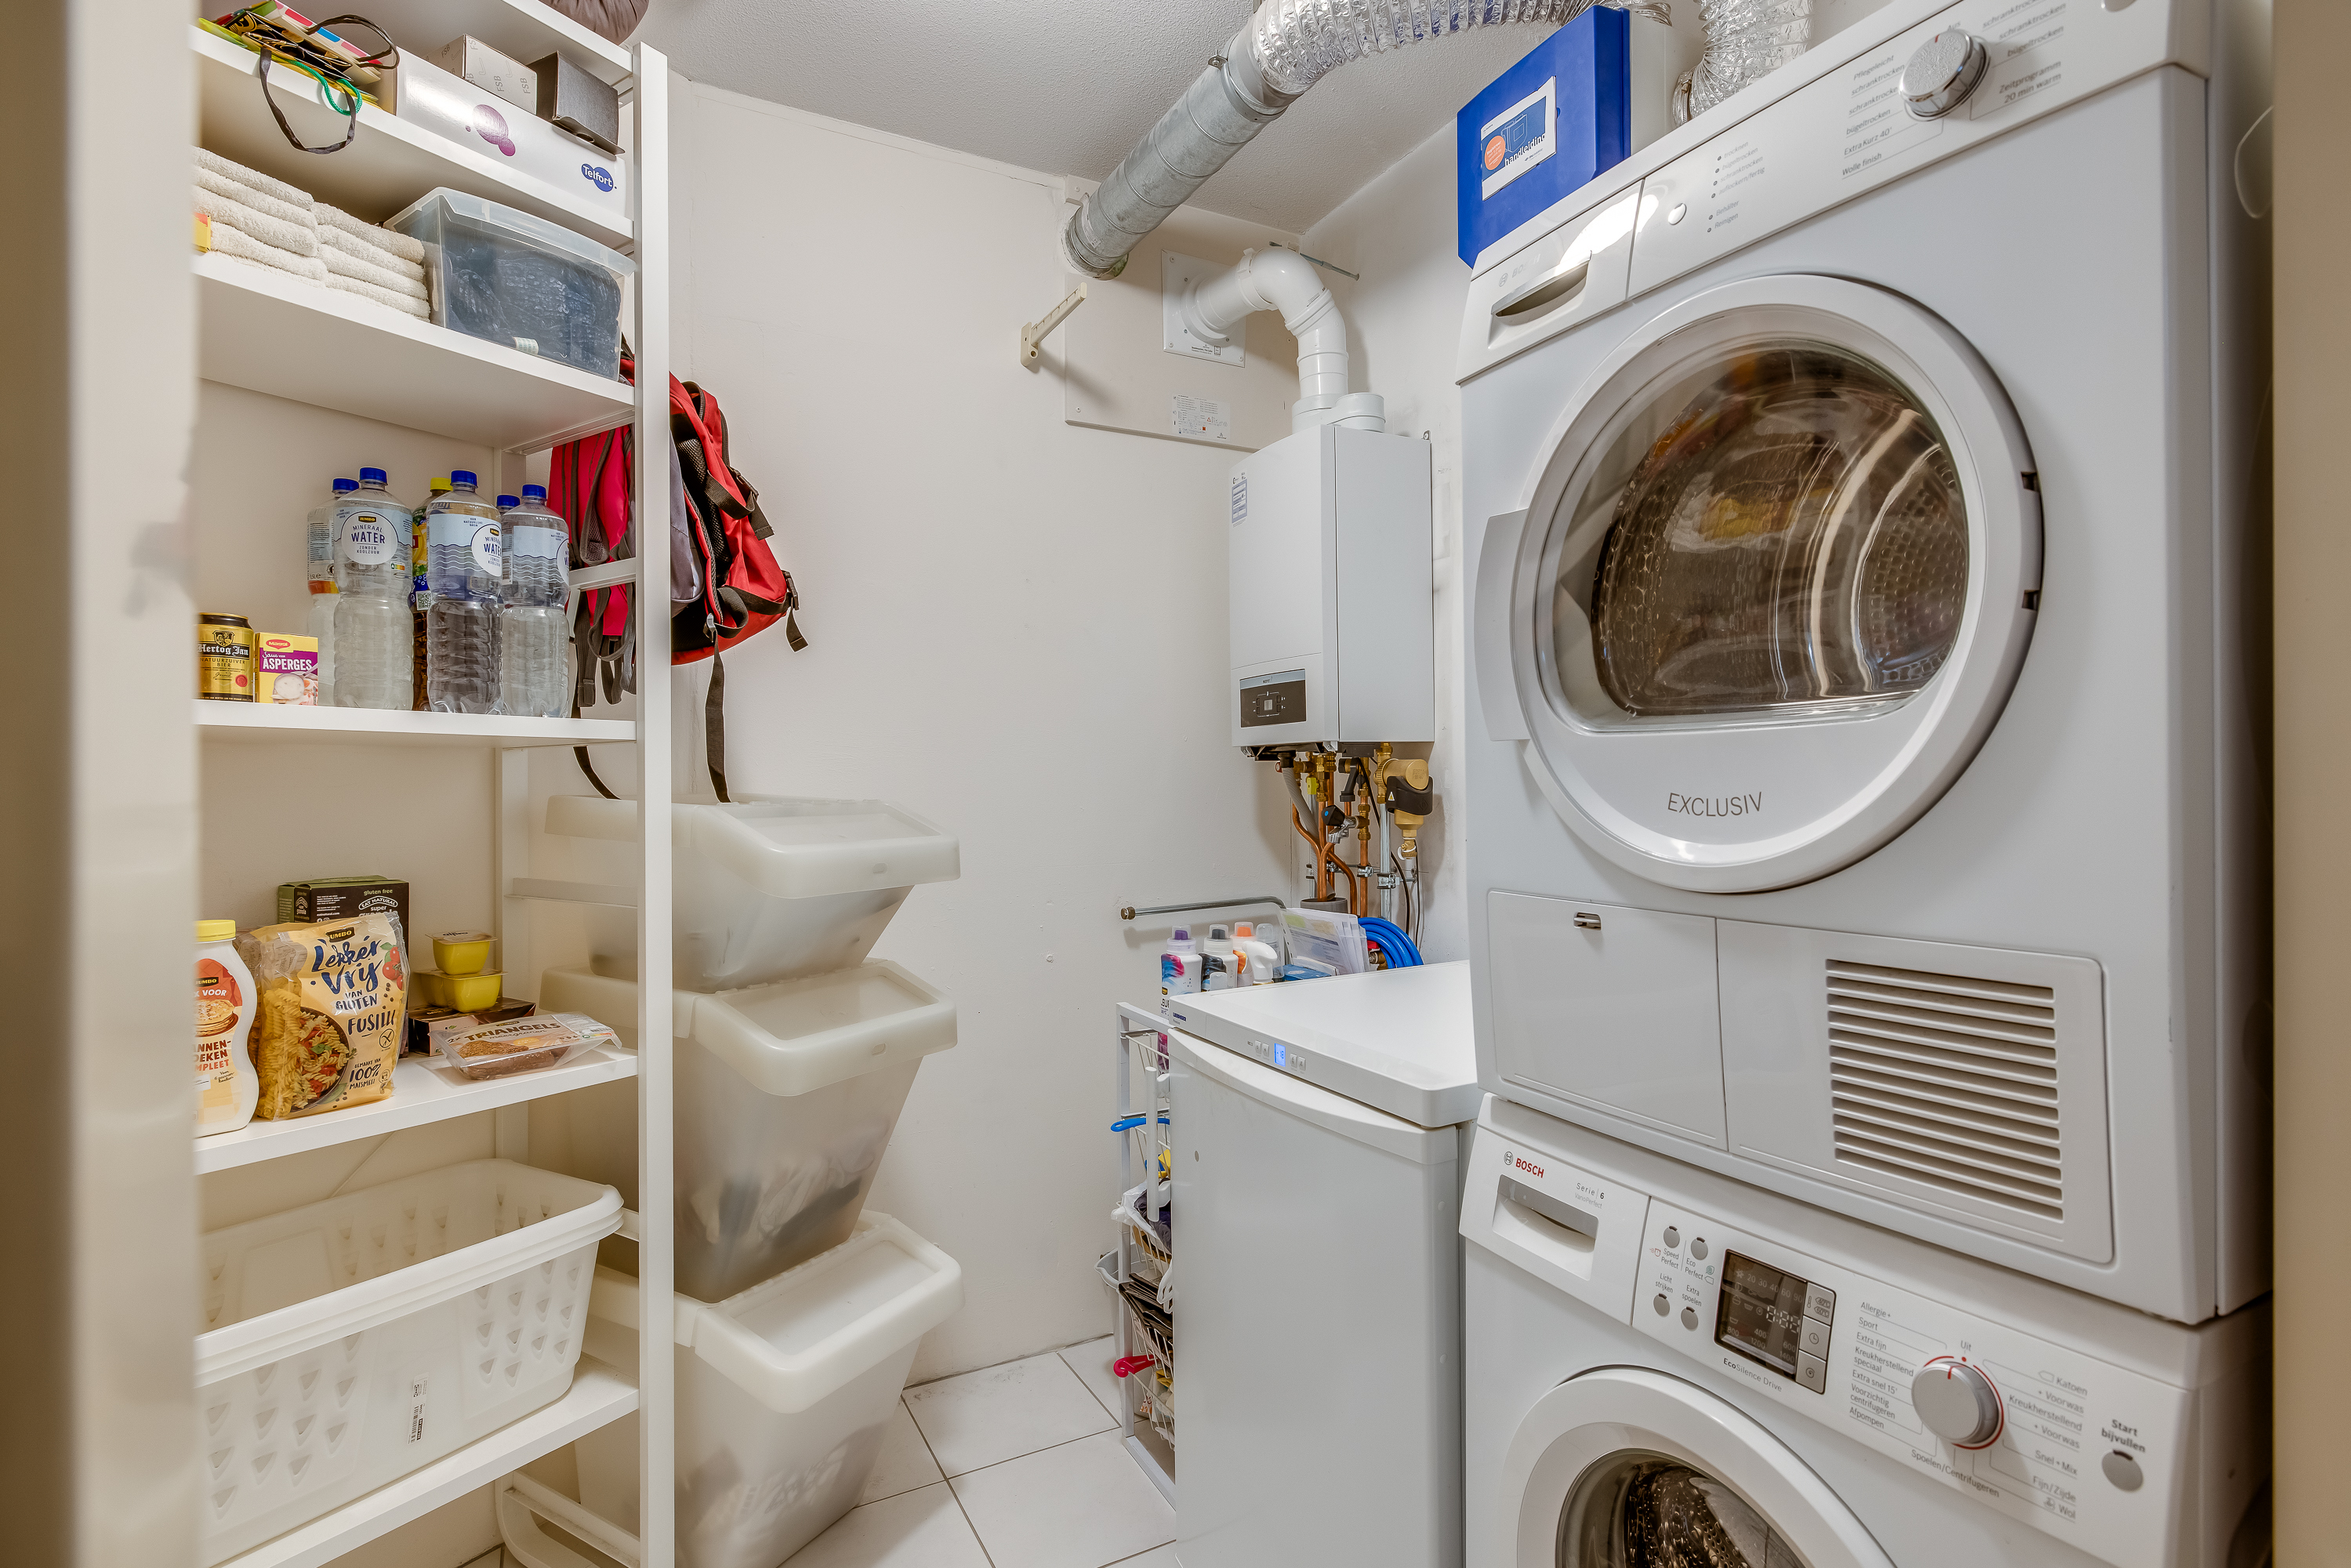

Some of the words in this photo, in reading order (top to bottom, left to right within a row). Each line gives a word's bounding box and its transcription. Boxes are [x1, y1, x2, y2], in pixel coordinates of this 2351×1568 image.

[441, 44, 451, 58] FSB
[1853, 55, 1894, 81] Pflegeleicht
[1999, 61, 2062, 93] Zeitprogramm
[494, 75, 504, 92] FSB
[521, 78, 531, 94] FSB
[1852, 64, 1905, 96] schranktrocken
[2005, 92, 2016, 103] 20
[2018, 85, 2034, 96] min
[2037, 74, 2061, 88] warm
[1846, 109, 1891, 135] bügeltrocken
[1724, 142, 1748, 158] trocknen
[1844, 143, 1862, 155] Extra
[1863, 134, 1878, 147] Kurz
[1720, 157, 1763, 183] schranktrocken
[1842, 163, 1861, 176] Wolle
[1863, 153, 1881, 167] finish
[582, 165, 613, 187] Telfort
[1716, 201, 1740, 216] Behälter
[1714, 213, 1739, 229] Reinigen
[351, 532, 386, 544] WATER
[197, 644, 231, 655] Hertog
[232, 645, 249, 656] Jan
[263, 658, 313, 670] ASPERGES
[1667, 791, 1761, 817] EXCLUSIV
[329, 930, 352, 939] UMBO
[311, 939, 382, 972] Lekker
[321, 960, 383, 995] Vrij
[345, 989, 362, 998] VAN
[348, 1009, 396, 1035] FUSILLI
[464, 1023, 561, 1041] TRIANGELS
[194, 1059, 229, 1072] MPLEET
[350, 1064, 382, 1083] 100%
[1515, 1157, 1545, 1178] BOSCH
[1576, 1182, 1595, 1196] Serie
[1574, 1192, 1603, 1210] VarioPerfect
[1661, 1256, 1679, 1269] Perfect
[1663, 1247, 1679, 1260] Speed
[1685, 1258, 1696, 1268] Eco
[1660, 1272, 1672, 1283] Licht
[1685, 1266, 1704, 1280] Perfect
[1655, 1280, 1674, 1294] strijken
[1686, 1284, 1700, 1296] Extra
[1747, 1273, 1756, 1283] 20
[1758, 1278, 1768, 1288] 30
[1769, 1283, 1780, 1293] 40
[1781, 1288, 1791, 1298] 60
[1793, 1294, 1803, 1303] 90
[1682, 1293, 1702, 1307] spoelen
[1860, 1301, 1887, 1318] Allergie
[1727, 1326, 1740, 1338] 800
[1754, 1327, 1767, 1339] 400
[1859, 1316, 1878, 1331] Sport
[1751, 1337, 1765, 1349] 1200
[1783, 1341, 1796, 1352] 600
[1856, 1331, 1874, 1345] Extra
[1875, 1339, 1887, 1351] fijn
[1961, 1340, 1972, 1352] Uit
[1779, 1350, 1795, 1364] 1400
[1854, 1356, 1882, 1373] speciaal
[1855, 1345, 1914, 1377] Kreukherstellend
[1723, 1357, 1761, 1382] EcoSilence
[1763, 1377, 1783, 1392] Drive
[1852, 1369, 1870, 1384] Extra
[1871, 1379, 1886, 1391] snel
[2056, 1376, 2088, 1396] Katoen
[1851, 1383, 1889, 1409] Voorzichtig
[2045, 1391, 2084, 1414] Voorwas
[1850, 1394, 1896, 1419] centrifugeren
[2009, 1394, 2083, 1432] Kreukherstellend
[1849, 1406, 1885, 1429] Afpompen
[2111, 1418, 2138, 1437] Start
[2041, 1425, 2080, 1449] Voorwas
[2101, 1427, 2146, 1453] bijvullen
[2034, 1449, 2055, 1465] Snel
[1911, 1448, 2000, 1498] Spoelen/Centrifugeren
[2059, 1503, 2077, 1519] Wol
